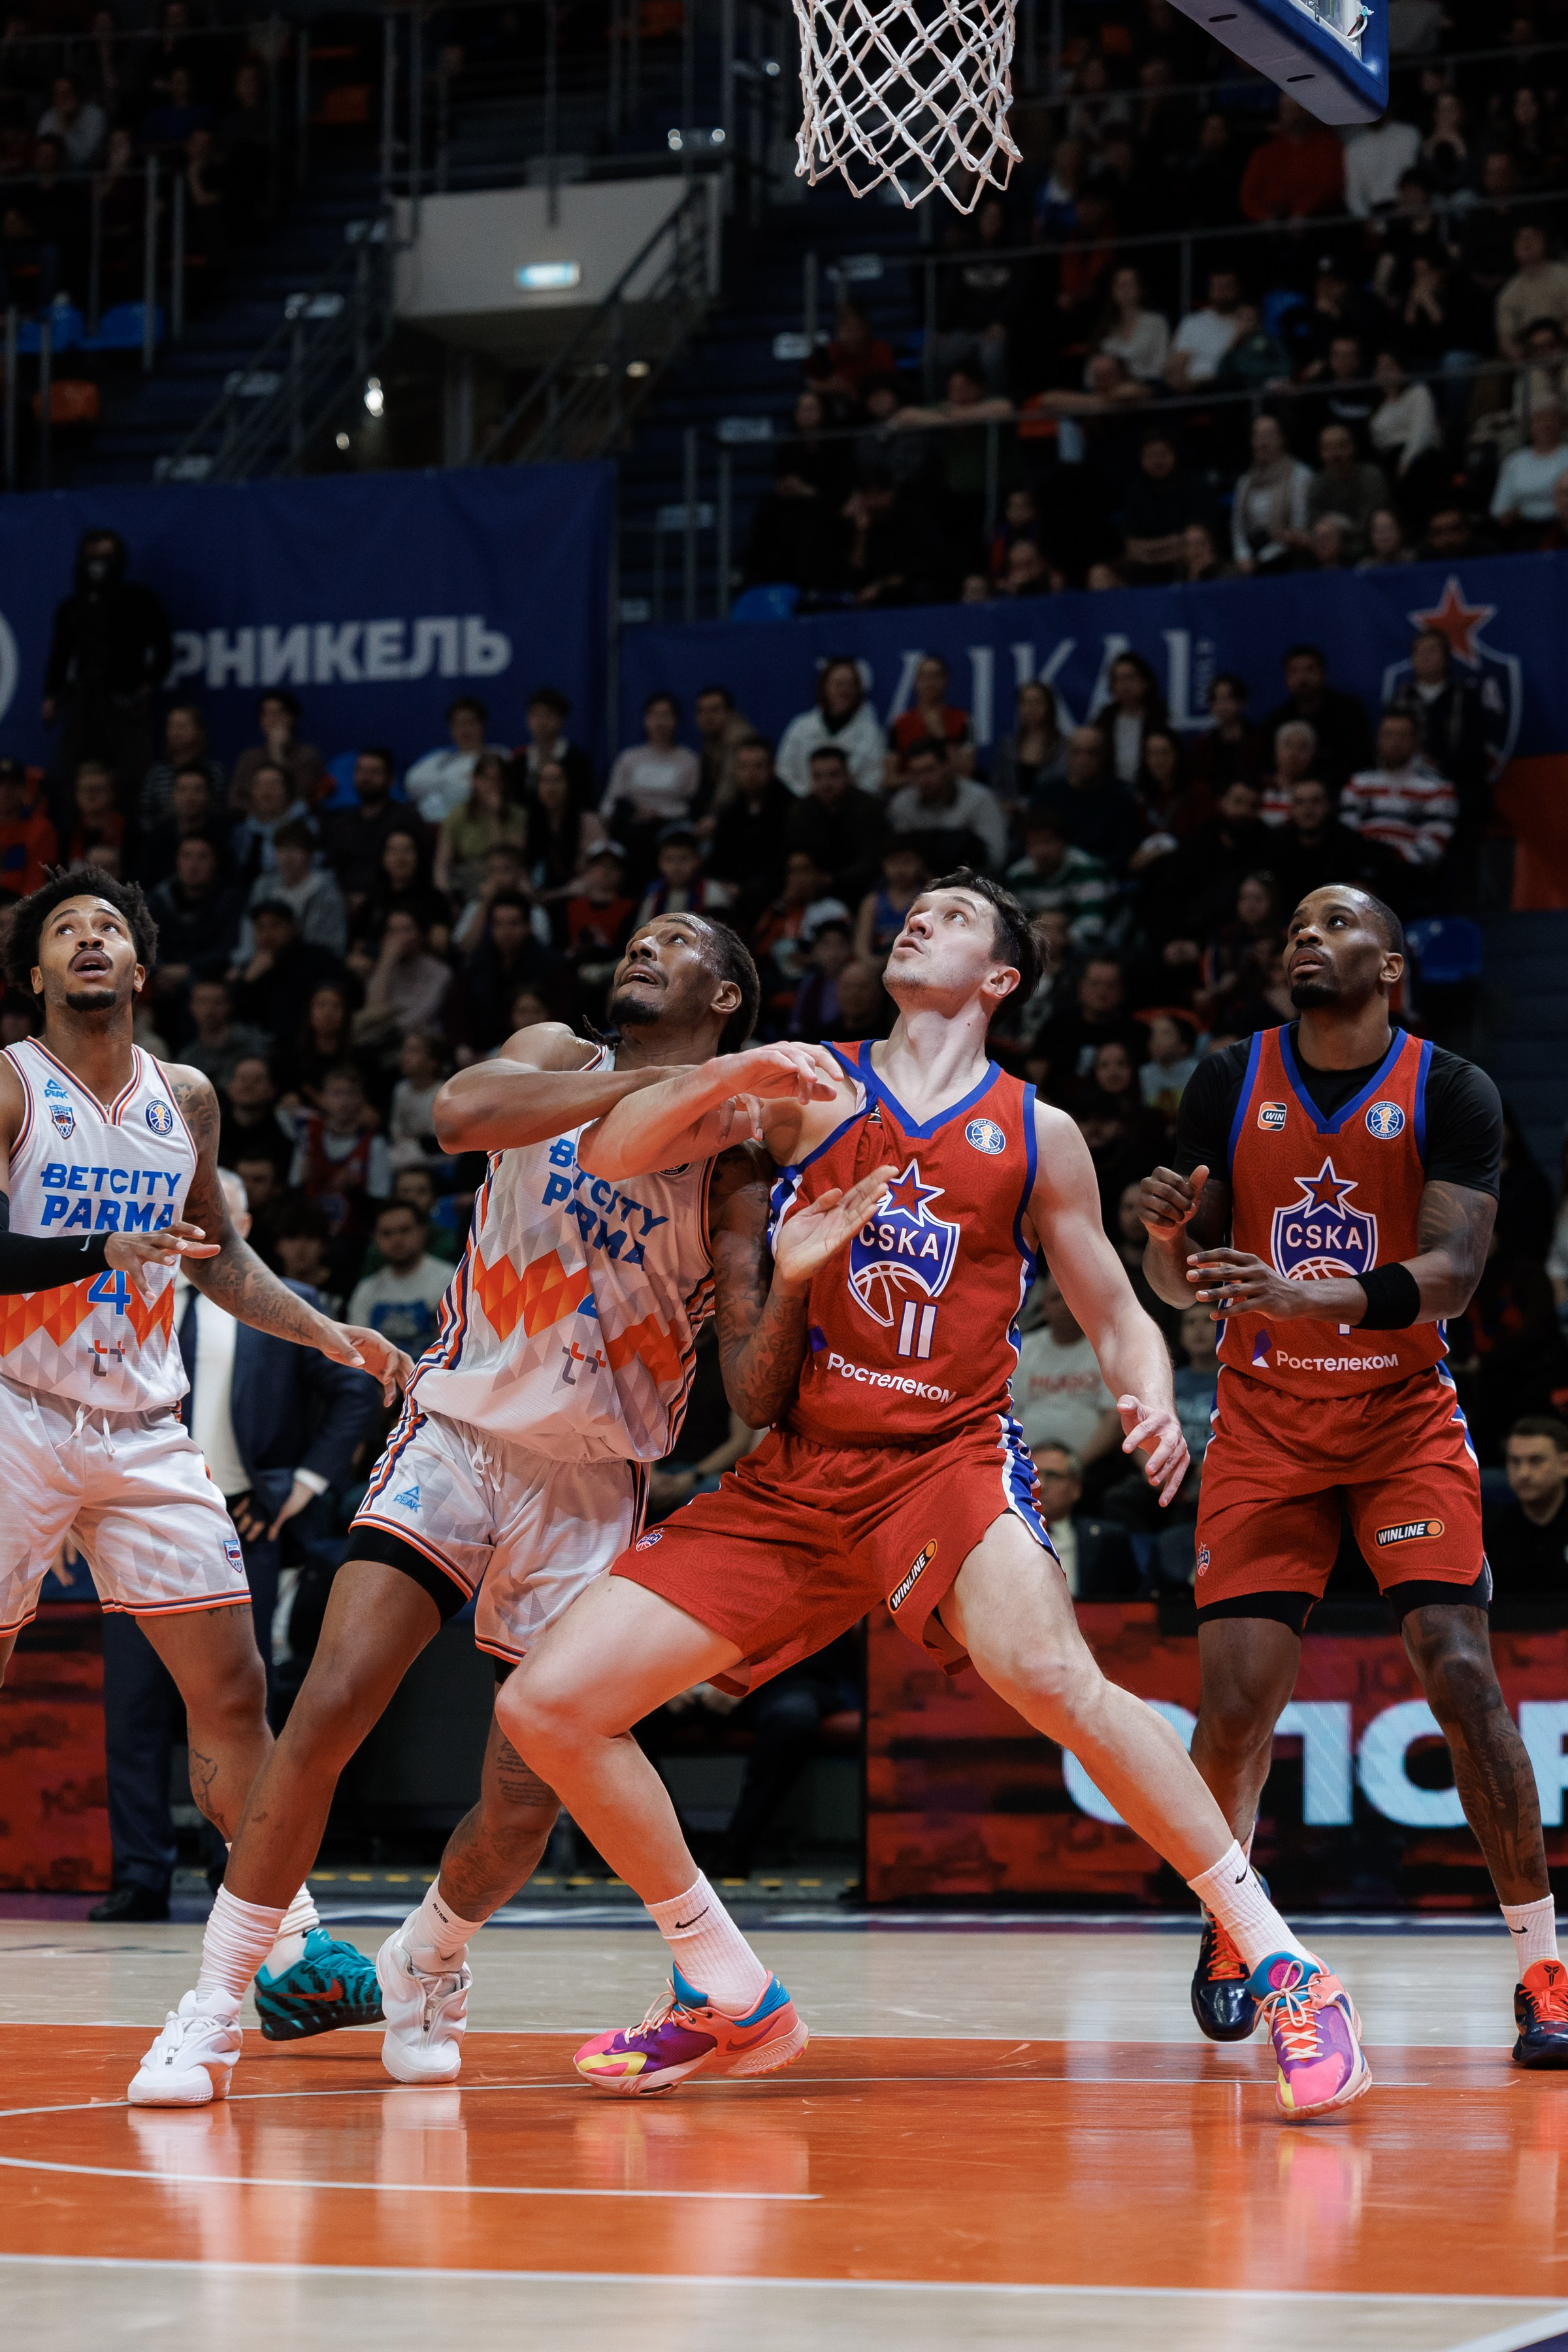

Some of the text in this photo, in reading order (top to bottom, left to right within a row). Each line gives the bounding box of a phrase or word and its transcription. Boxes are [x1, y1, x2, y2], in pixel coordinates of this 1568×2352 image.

[67, 613, 514, 691] РНИКЕЛЬ
[44, 1088, 69, 1099] PEAK
[1266, 1112, 1284, 1121] WIN
[40, 1163, 182, 1197] BETCITY
[548, 1138, 670, 1237] BTCITY
[40, 1194, 174, 1232] PARMA
[858, 1222, 939, 1260] CSKA
[1286, 1223, 1364, 1250] CSKA
[87, 1269, 131, 1316] 4
[896, 1299, 938, 1360] 11
[826, 1352, 957, 1403] Ростелеком
[1276, 1350, 1399, 1371] Ростелеком
[393, 1494, 423, 1514] PEAK
[1378, 1524, 1426, 1544] WINLINE
[892, 1553, 926, 1609] WINLINE
